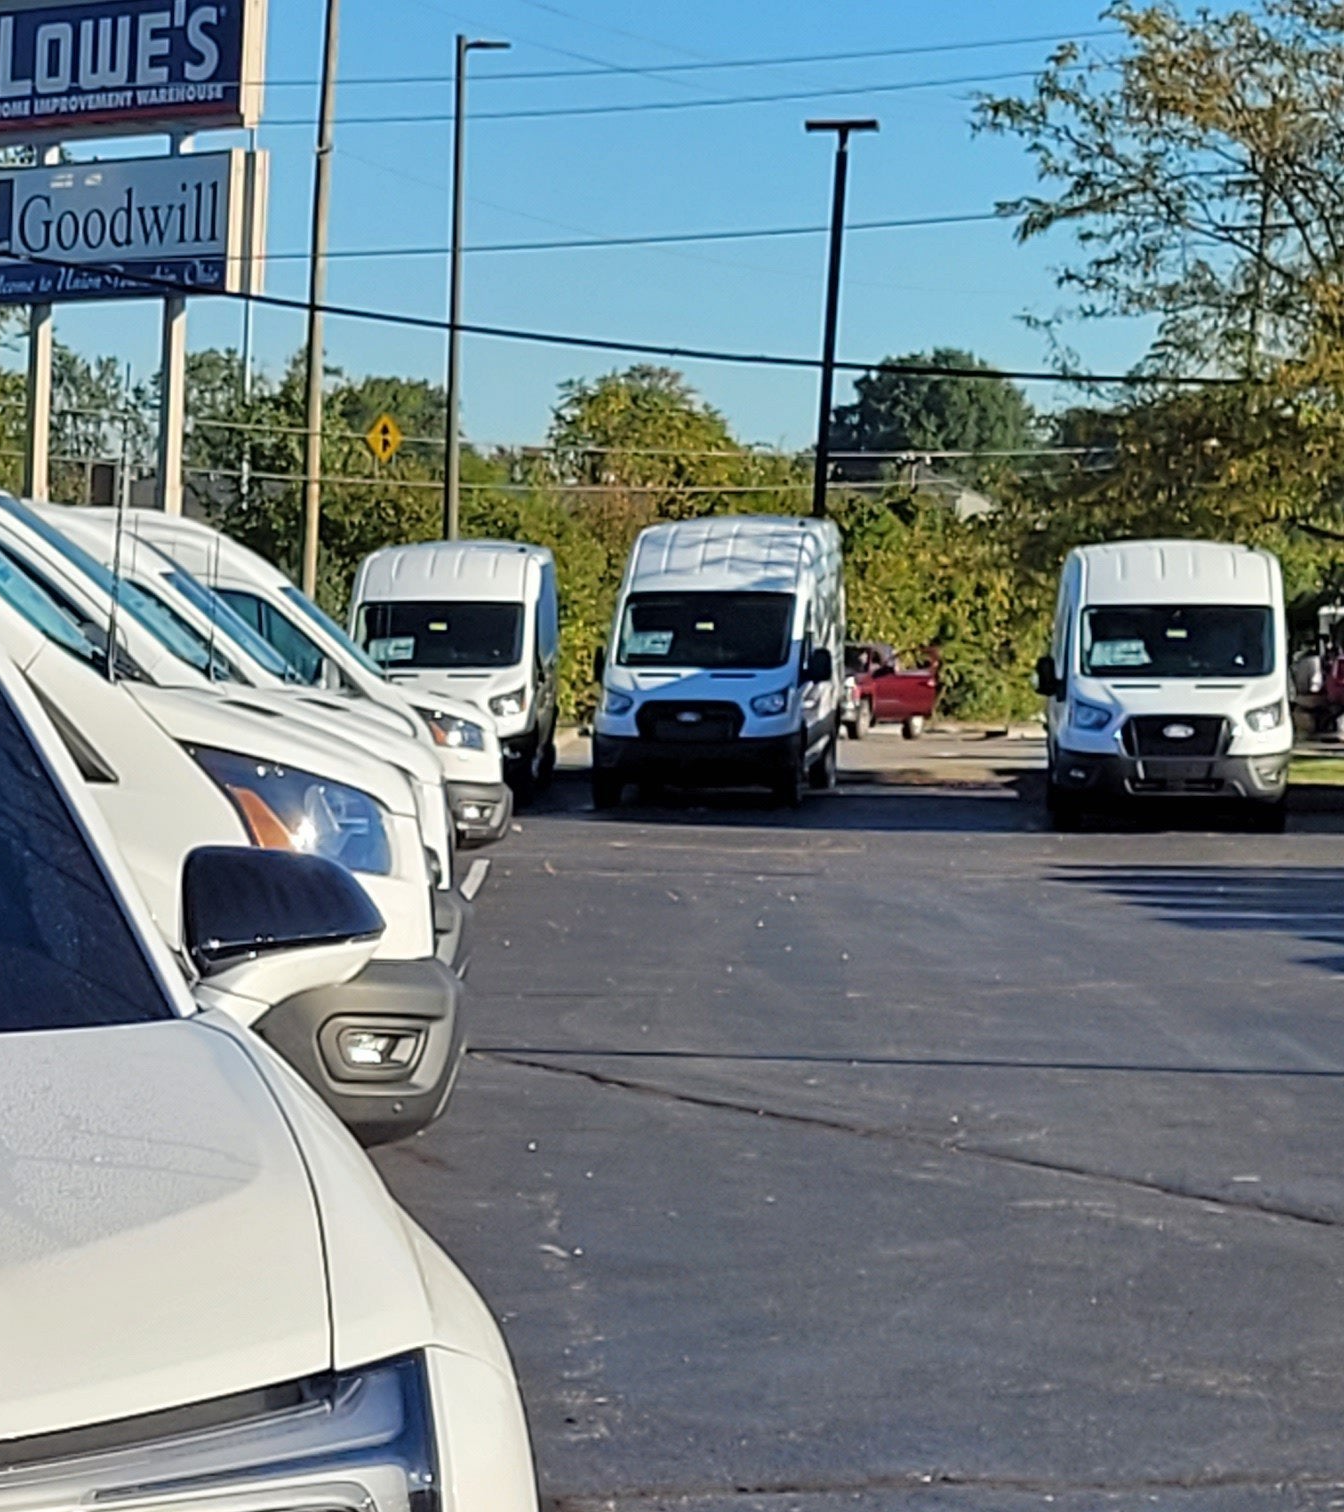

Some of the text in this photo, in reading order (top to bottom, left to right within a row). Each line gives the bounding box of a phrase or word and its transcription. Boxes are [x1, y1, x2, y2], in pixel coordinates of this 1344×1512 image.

[33, 94, 133, 116] IMPROVEMENT
[136, 86, 224, 106] WAREHOUSE
[18, 180, 219, 254] Goodwill
[57, 266, 103, 291] Union
